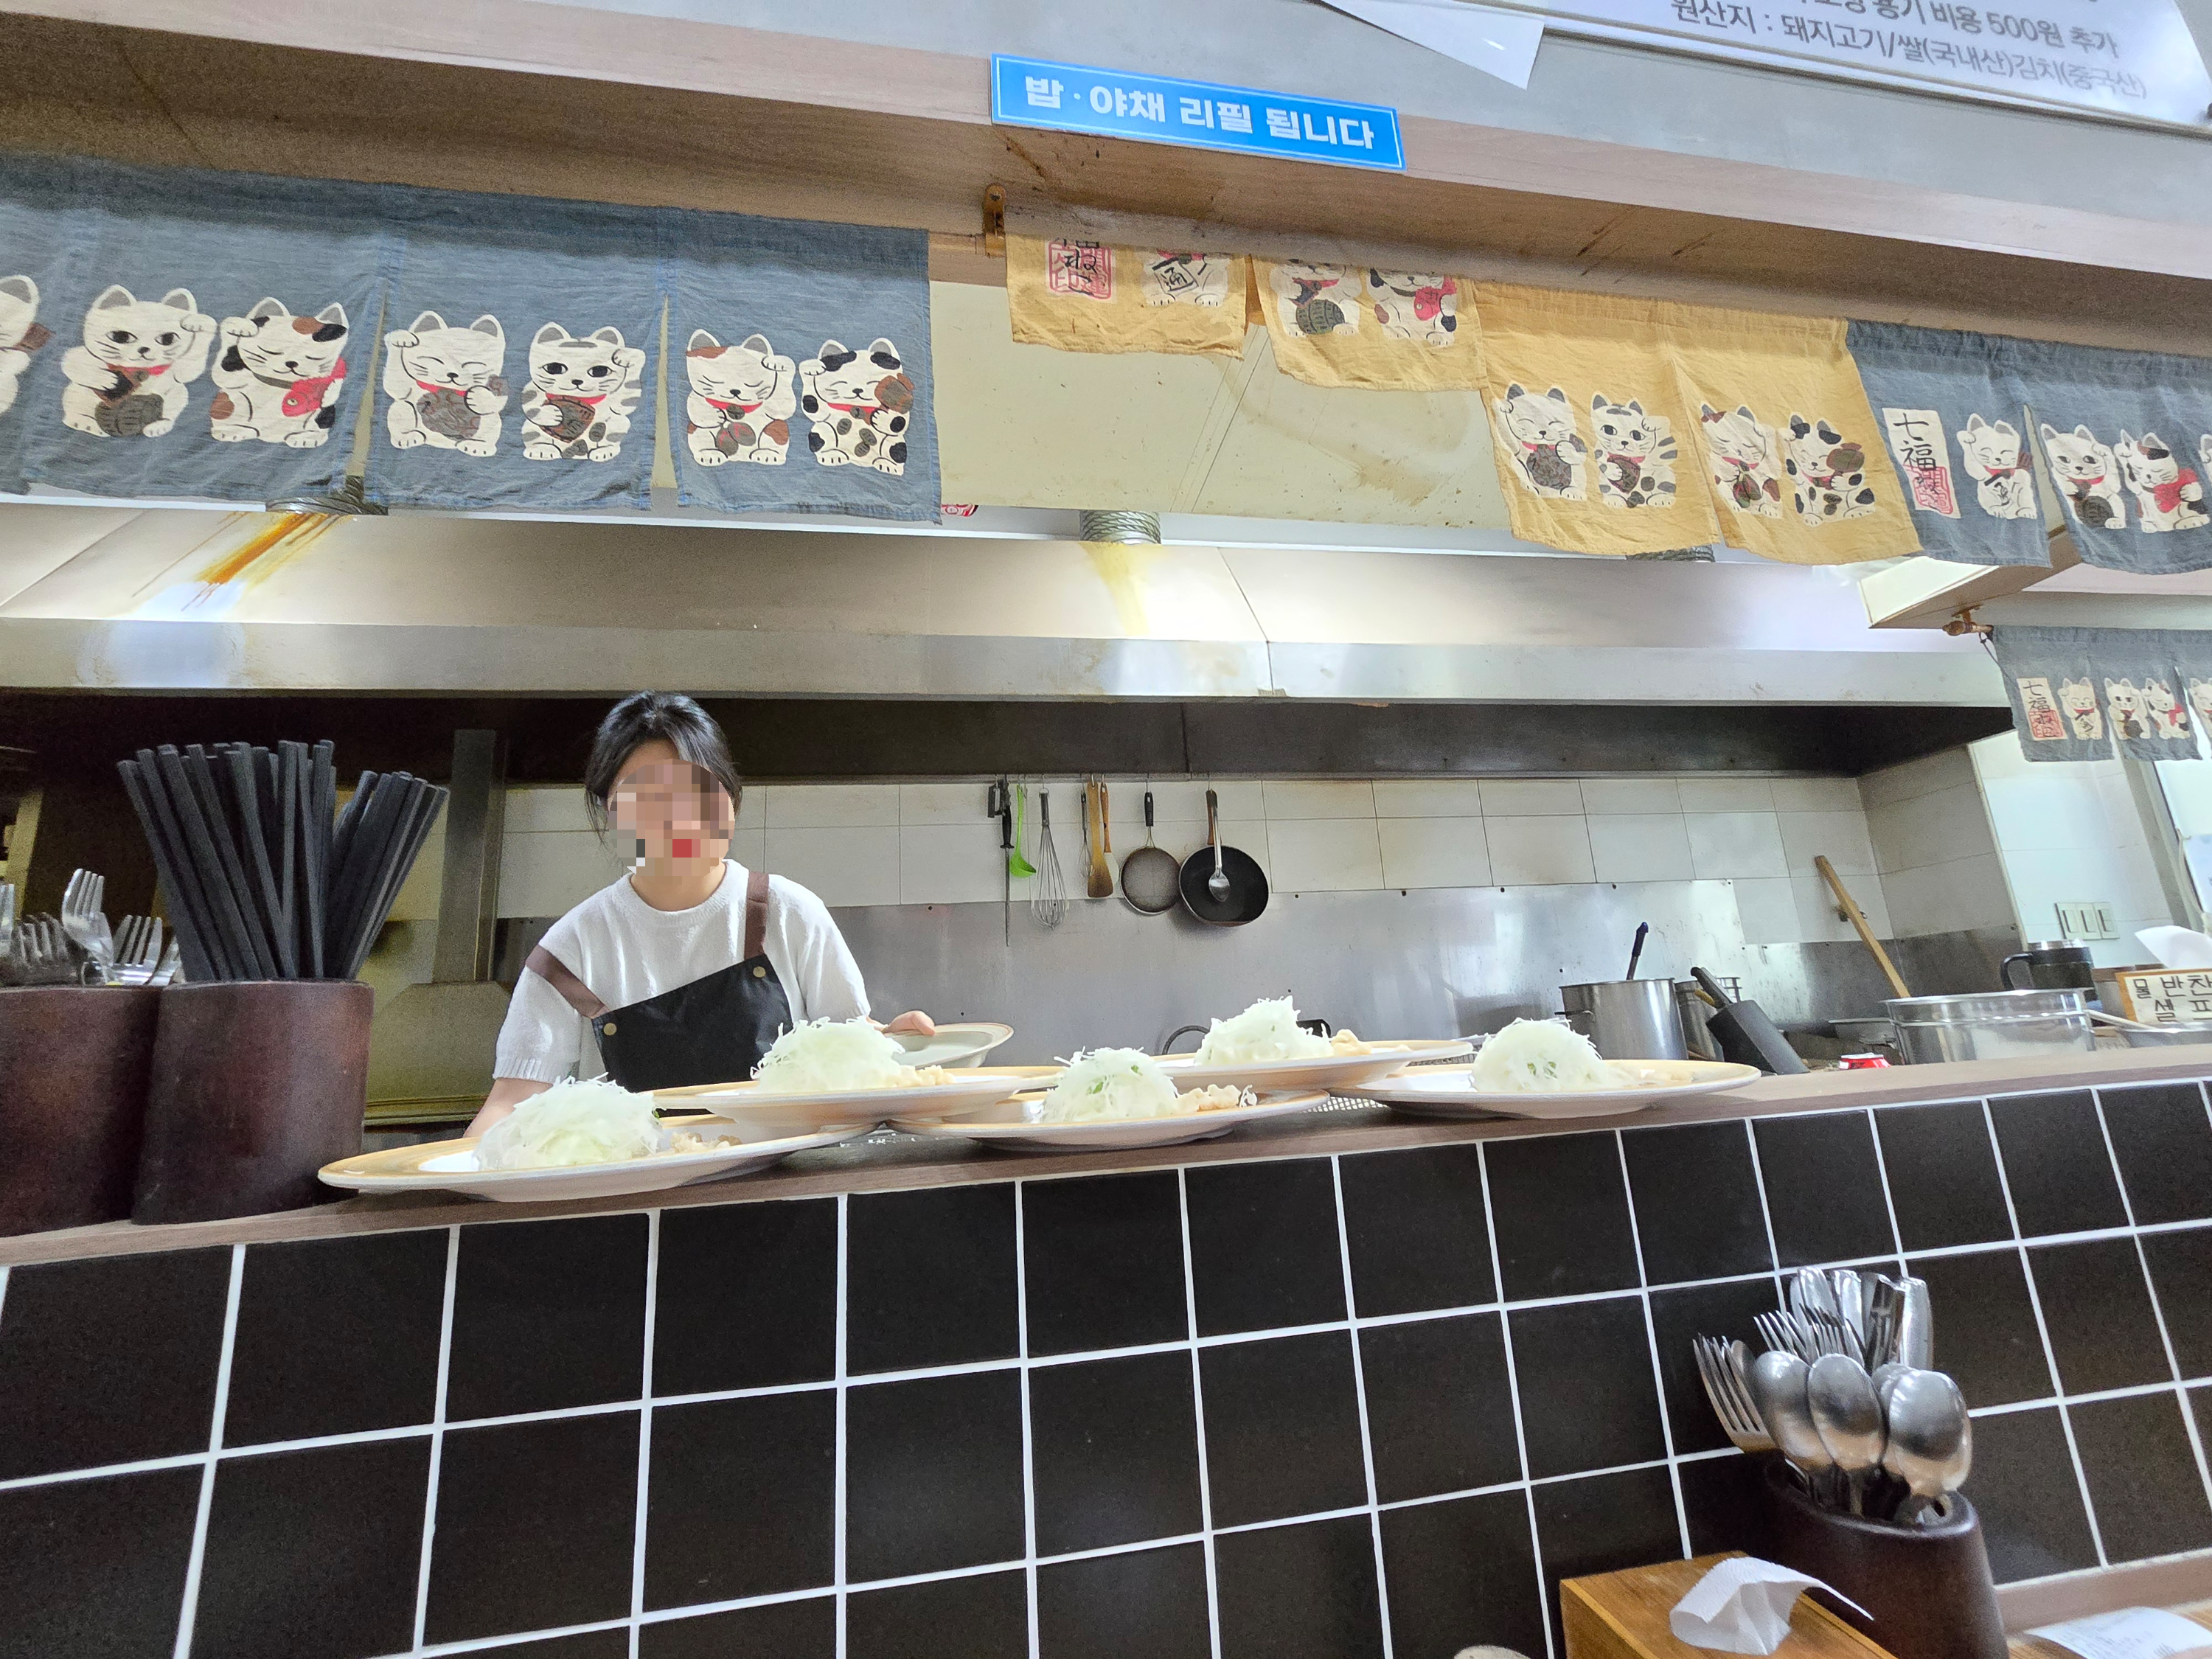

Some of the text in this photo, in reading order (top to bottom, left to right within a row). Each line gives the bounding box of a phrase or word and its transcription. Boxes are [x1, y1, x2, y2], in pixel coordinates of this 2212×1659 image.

[1670, 0, 1757, 35] 원산지
[1930, 1, 1983, 34] 비용
[1986, 10, 2066, 49] 500원
[2070, 27, 2119, 59] 추가
[1180, 97, 1253, 133] 리필
[1266, 107, 1374, 150] 됩니다
[2132, 978, 2152, 999] 물
